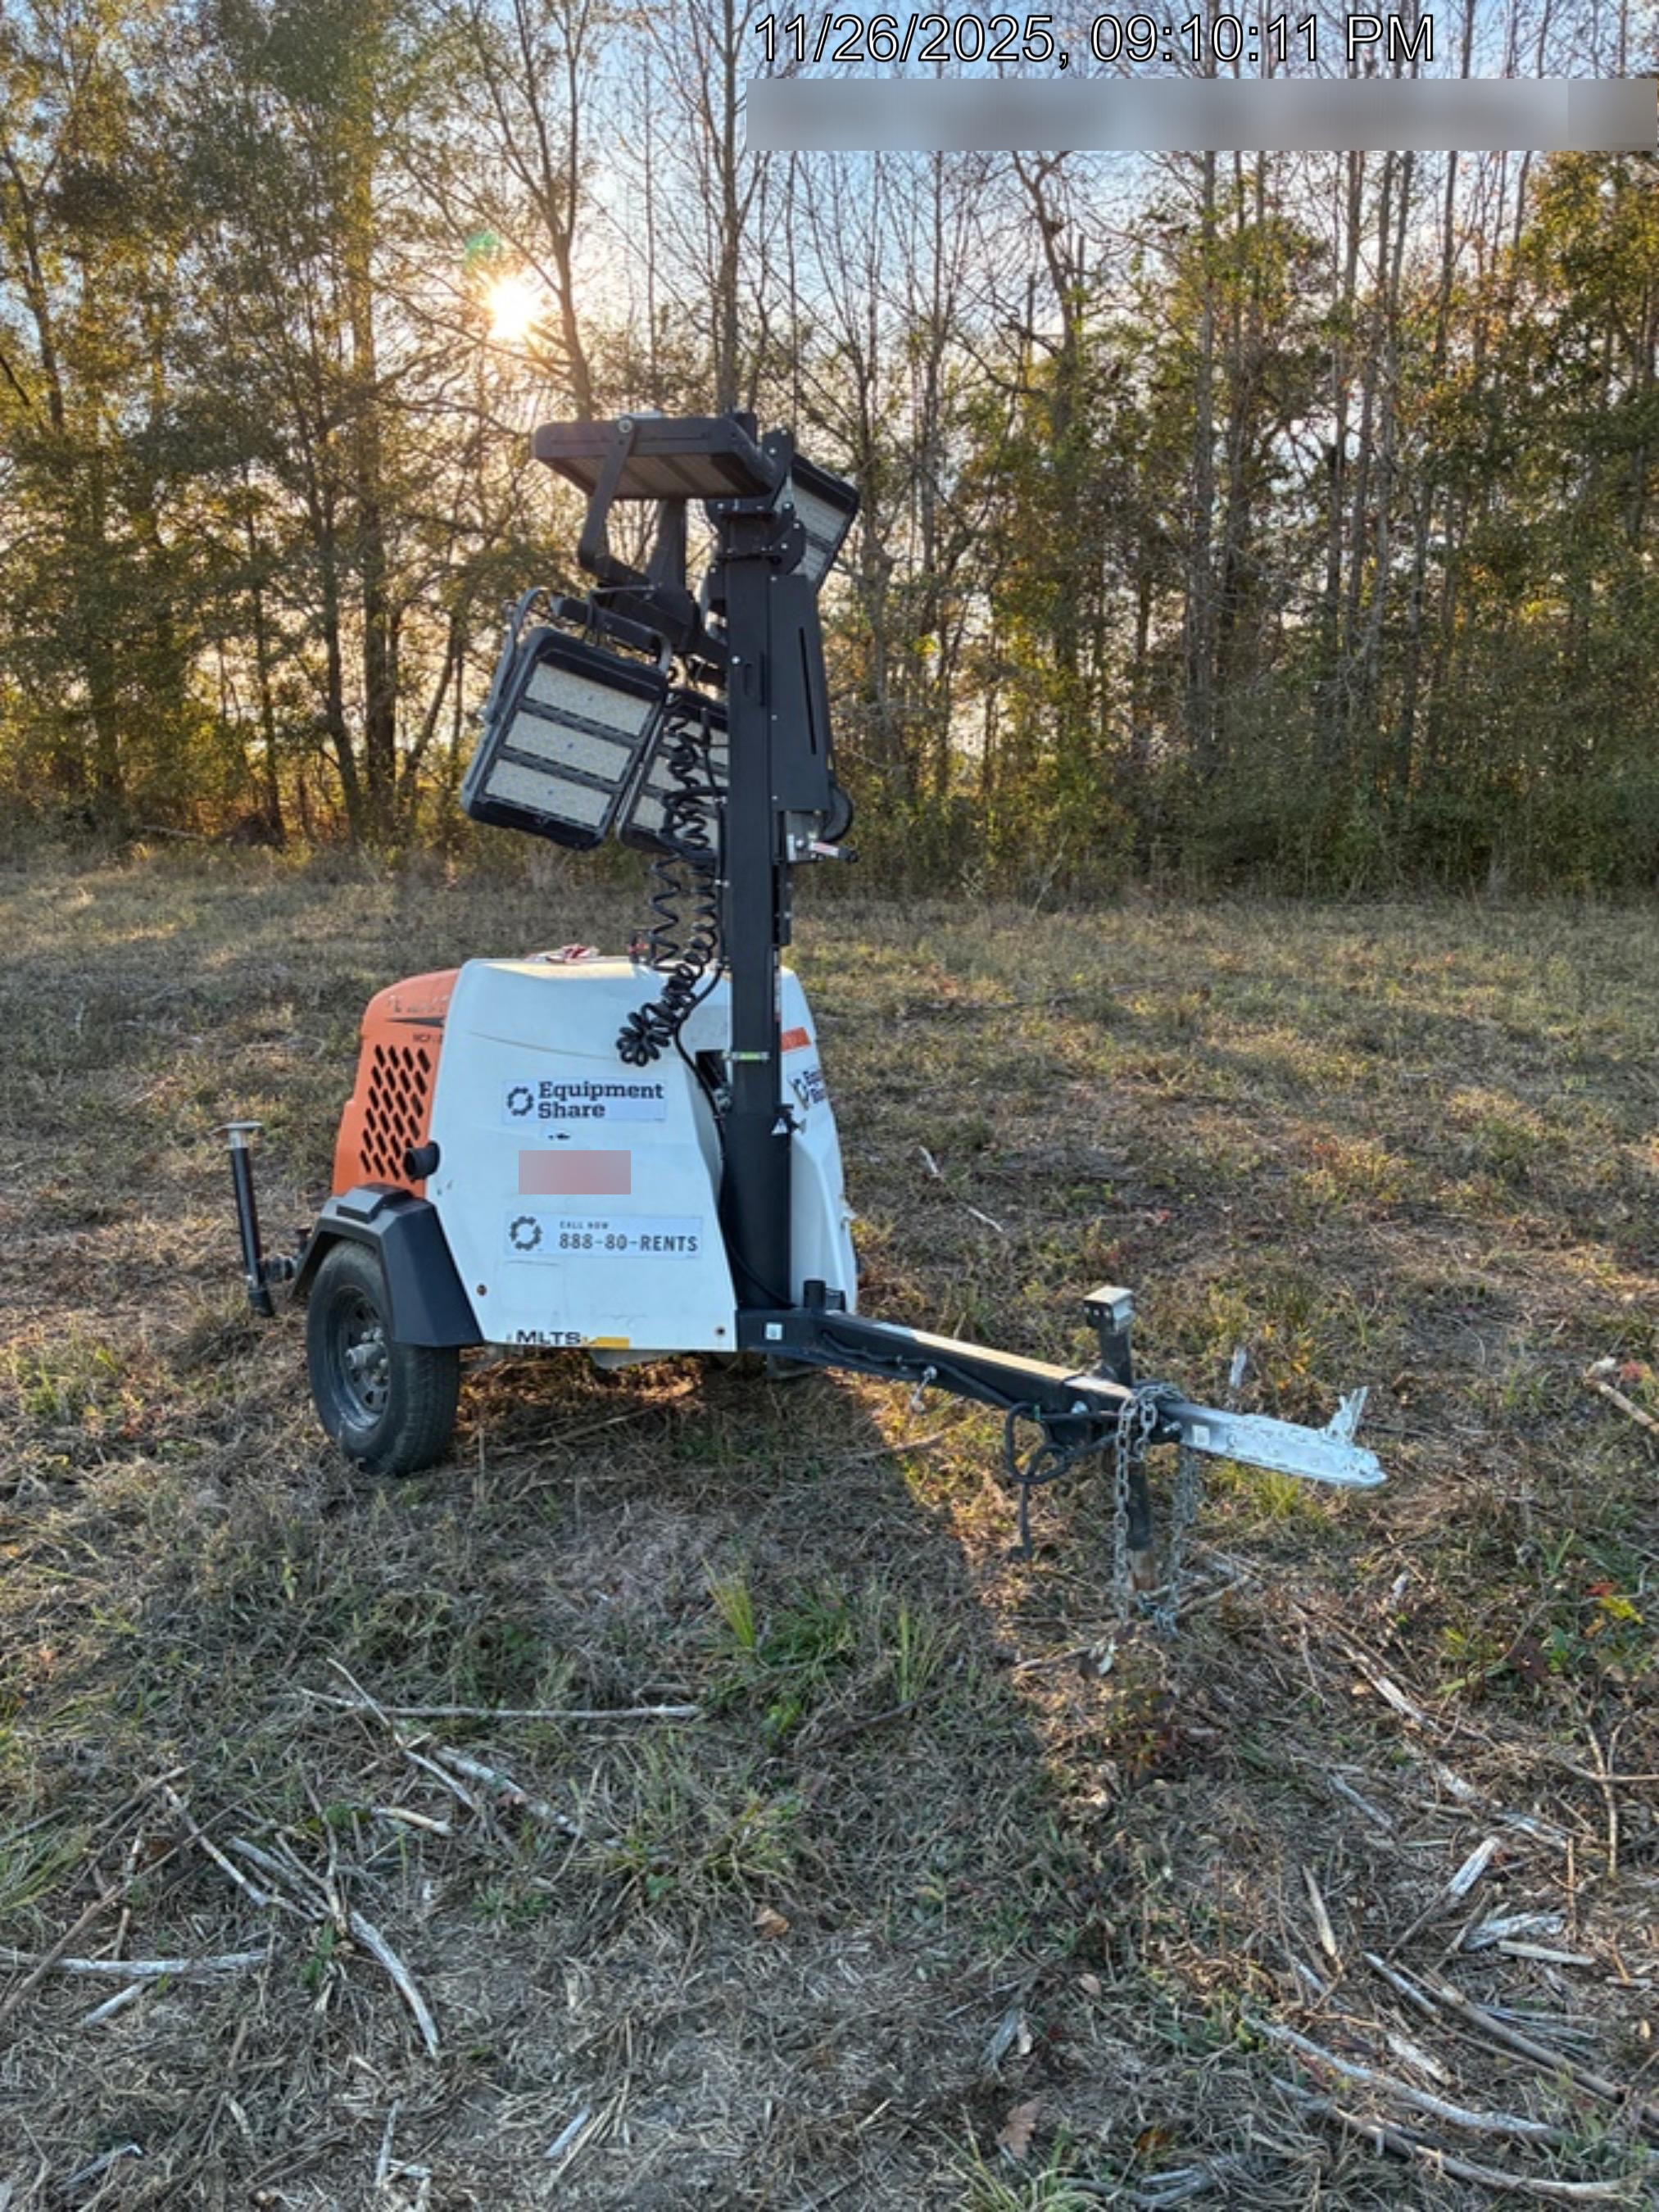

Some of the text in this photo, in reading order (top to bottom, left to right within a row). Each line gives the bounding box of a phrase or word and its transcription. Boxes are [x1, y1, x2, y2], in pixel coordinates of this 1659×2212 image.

[537, 1080, 664, 1101] Equipment
[537, 1101, 605, 1119] Share
[559, 1221, 584, 1229] CALL
[559, 1232, 698, 1252] 888-80-RENTS
